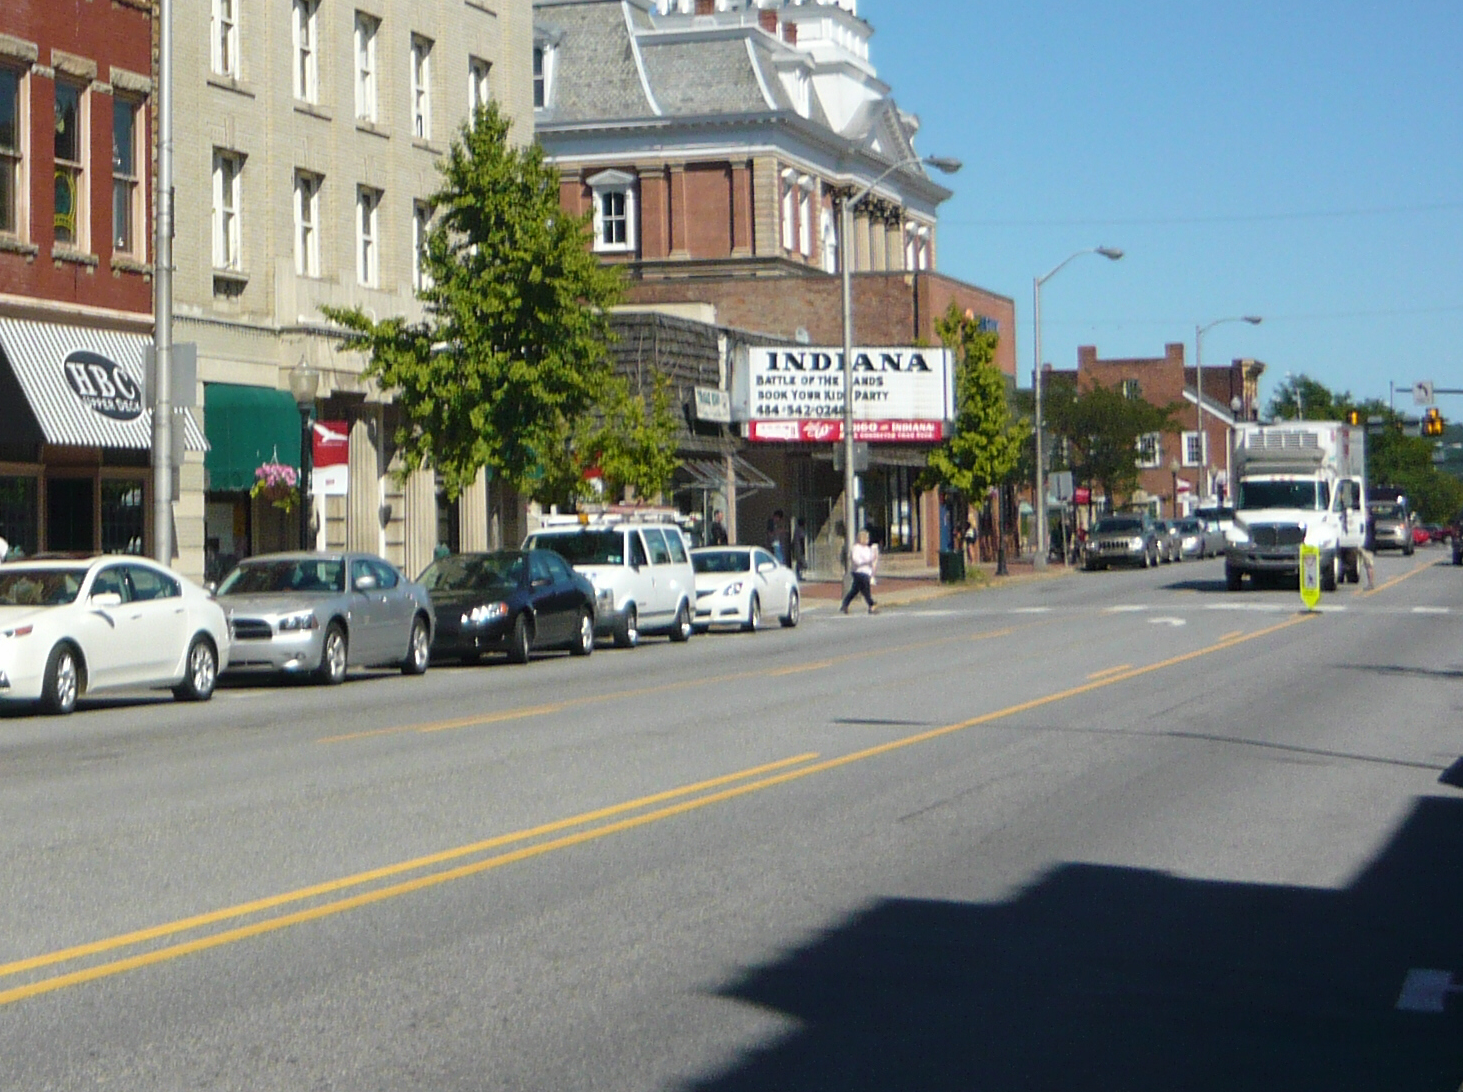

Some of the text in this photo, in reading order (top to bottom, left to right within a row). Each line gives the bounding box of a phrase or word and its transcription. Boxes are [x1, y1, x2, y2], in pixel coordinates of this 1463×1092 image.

[766, 352, 932, 372] INDIANA
[66, 361, 135, 399] HBC
[756, 375, 884, 386] BATTLE OF THE ANDS
[758, 390, 889, 401] BOOK YOUR KID PARTY
